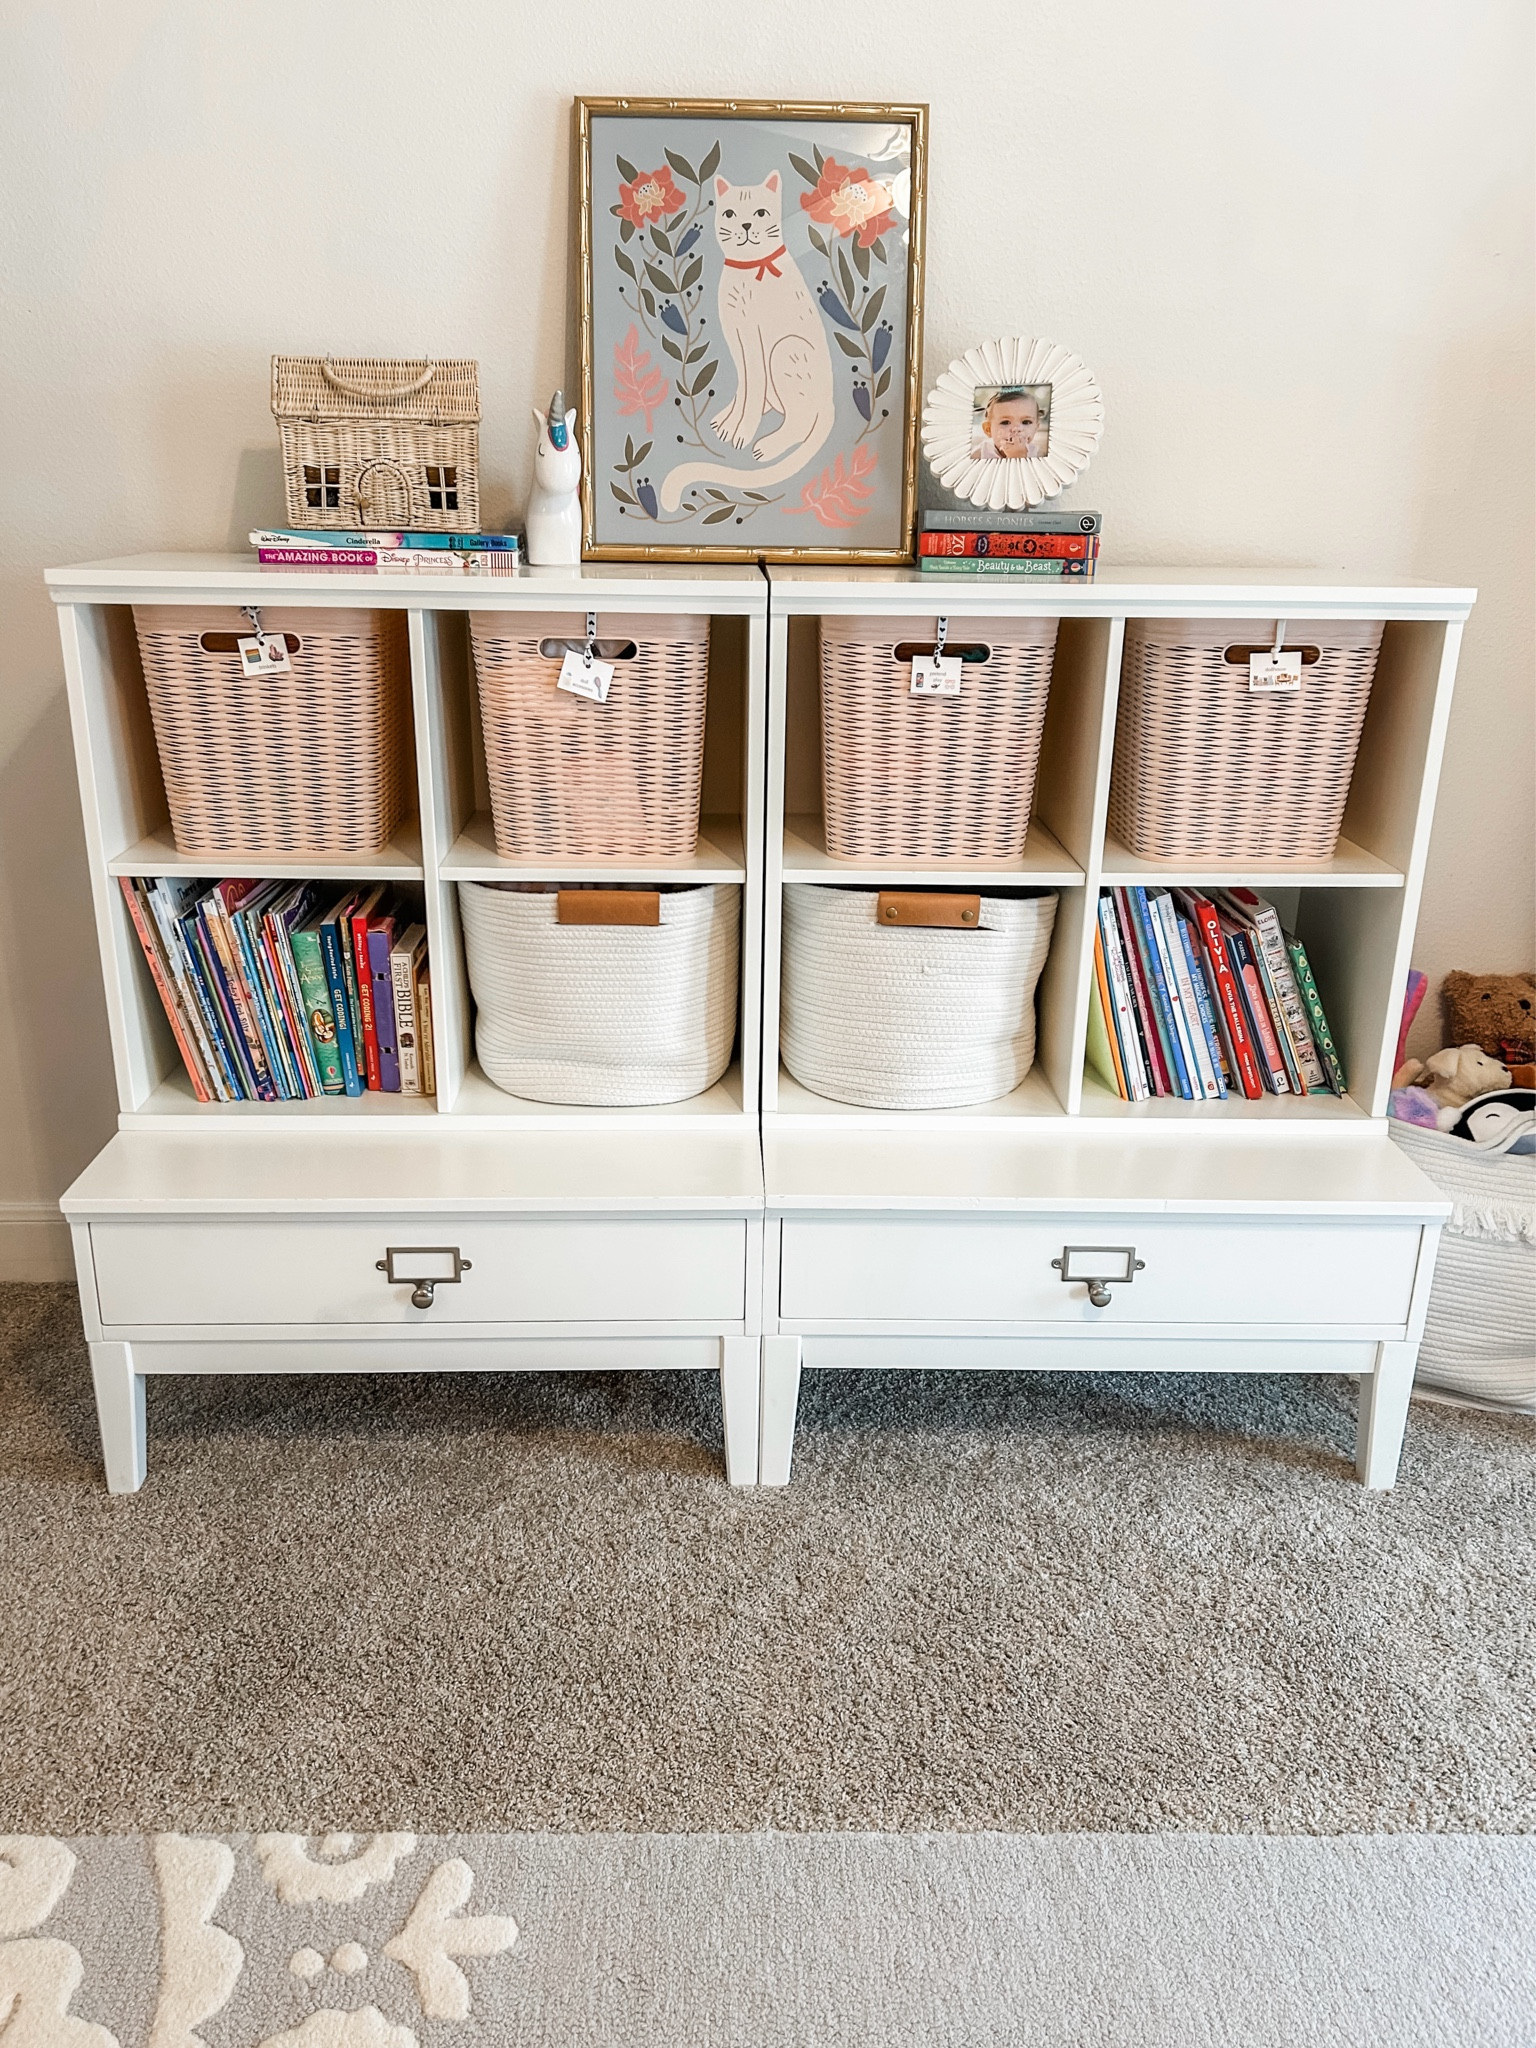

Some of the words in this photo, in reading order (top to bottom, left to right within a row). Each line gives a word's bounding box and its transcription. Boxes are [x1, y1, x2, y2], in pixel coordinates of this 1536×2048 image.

[944, 516, 983, 525] HORSES
[997, 516, 1034, 526] PONIES
[470, 540, 489, 548] Gallery
[277, 552, 328, 562] AMAZING
[332, 553, 364, 562] BOOK
[977, 560, 1010, 574] Beauty
[1024, 560, 1052, 574] Beast
[1207, 920, 1229, 973] OLIVIA
[1237, 940, 1247, 961] CARROLL
[393, 963, 403, 989] FIRST
[1180, 977, 1189, 986] IN
[1191, 973, 1198, 982] MY
[334, 989, 343, 1003] GET
[361, 984, 369, 997] GET
[1183, 986, 1192, 1000] MY
[1194, 982, 1204, 1004] MAGICAL
[226, 977, 240, 999] Today
[235, 1002, 245, 1016] Feel
[240, 1017, 251, 1033] Silly
[363, 998, 372, 1022] CODING
[396, 989, 415, 1029] BIBLE
[1186, 1000, 1199, 1028] HEART
[1199, 1003, 1209, 1024] CHOICES
[1224, 983, 1234, 1002] OLIVIA
[1232, 1013, 1245, 1044] BALLERINA
[336, 1003, 347, 1030] CODING!
